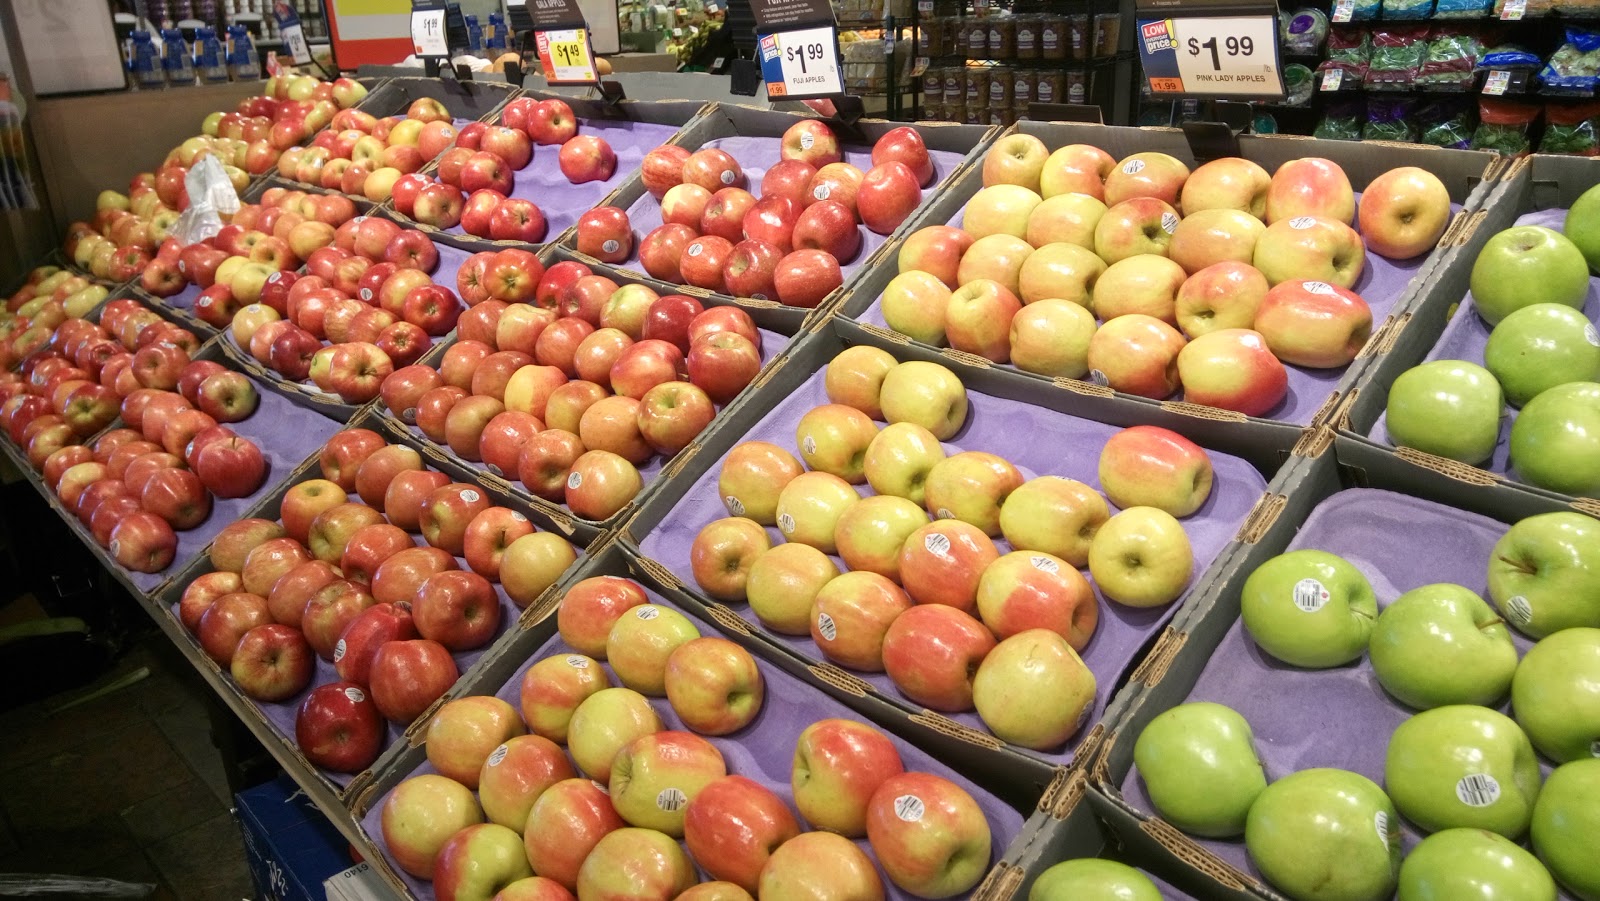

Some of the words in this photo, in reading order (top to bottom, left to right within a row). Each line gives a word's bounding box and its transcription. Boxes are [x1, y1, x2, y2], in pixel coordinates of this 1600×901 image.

[1144, 24, 1165, 37] LOW
[762, 39, 775, 49] LOW
[805, 75, 826, 83] APPLES
[1215, 75, 1234, 83] LADY
[1236, 75, 1266, 83] APPLES
[344, 863, 369, 878] 6140
